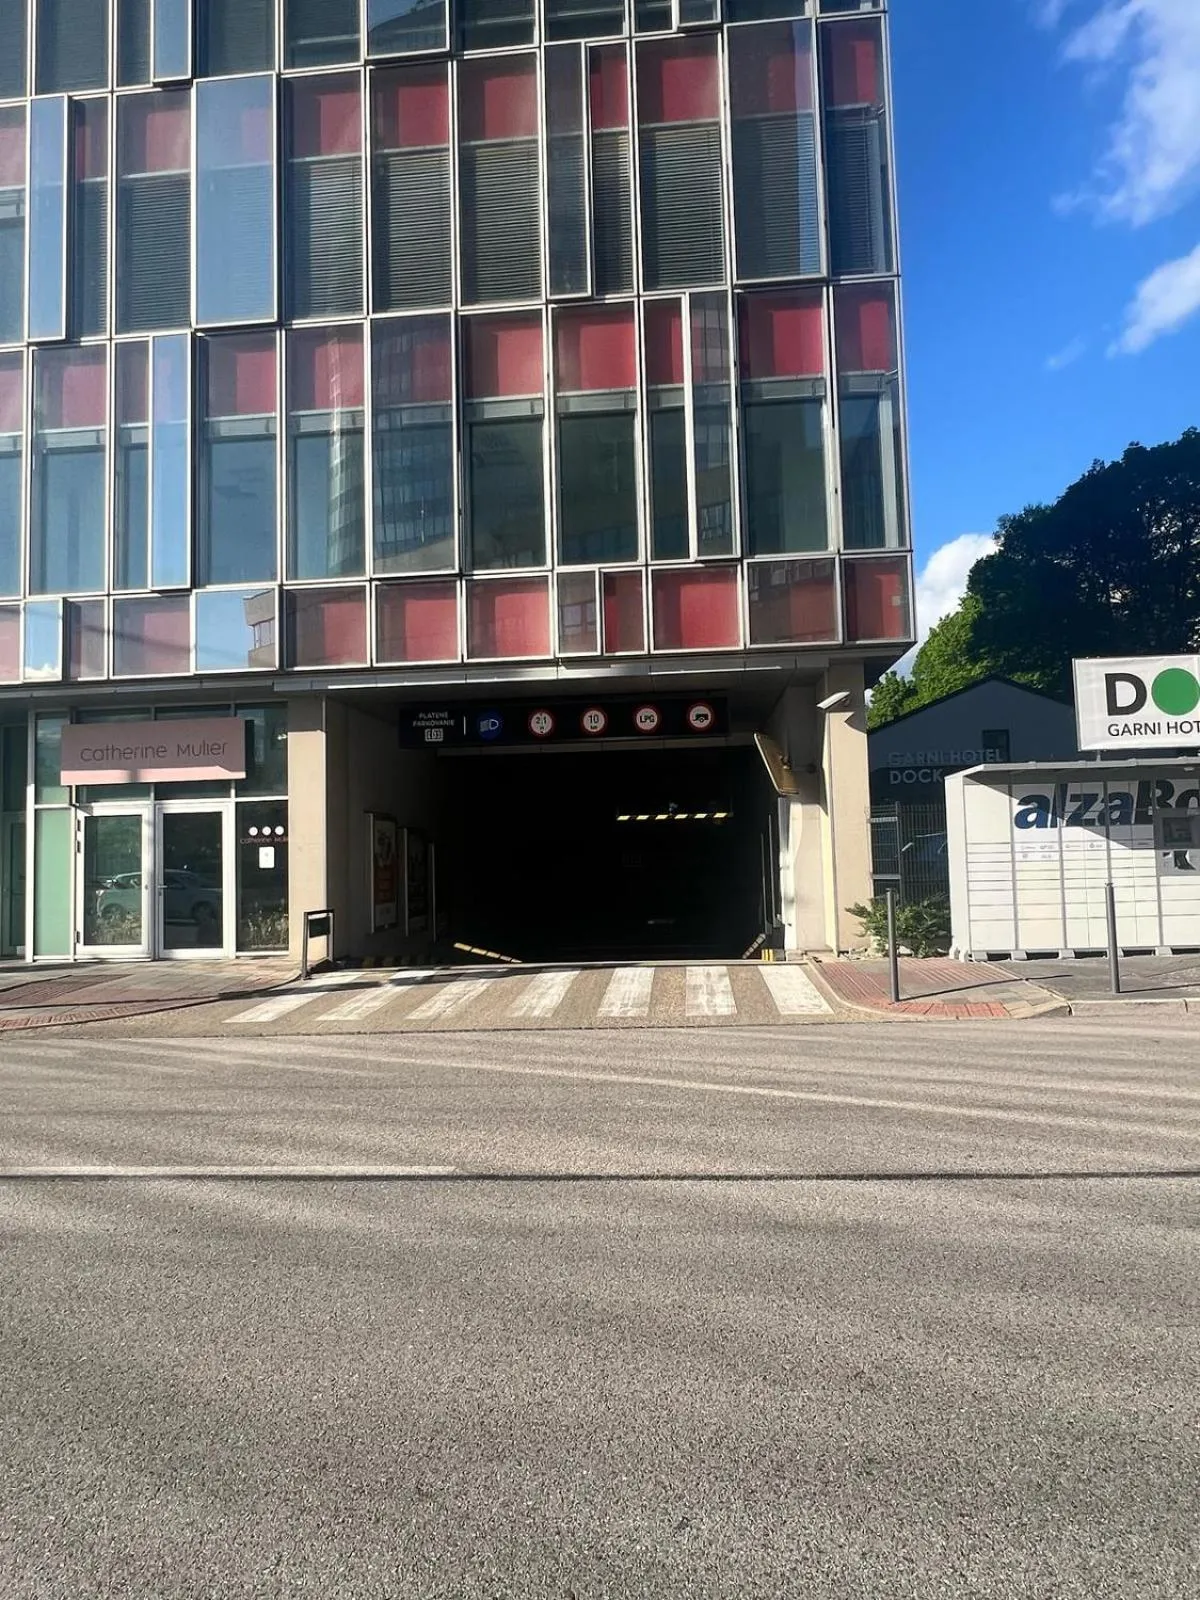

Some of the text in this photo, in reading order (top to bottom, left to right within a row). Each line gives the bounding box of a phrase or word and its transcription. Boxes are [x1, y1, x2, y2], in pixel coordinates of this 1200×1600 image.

[588, 714, 599, 724] 10
[640, 715, 655, 723] LPG
[1107, 721, 1162, 737] GARNI
[888, 748, 1004, 766] GARNI HOTEL
[890, 769, 944, 785] DOCK
